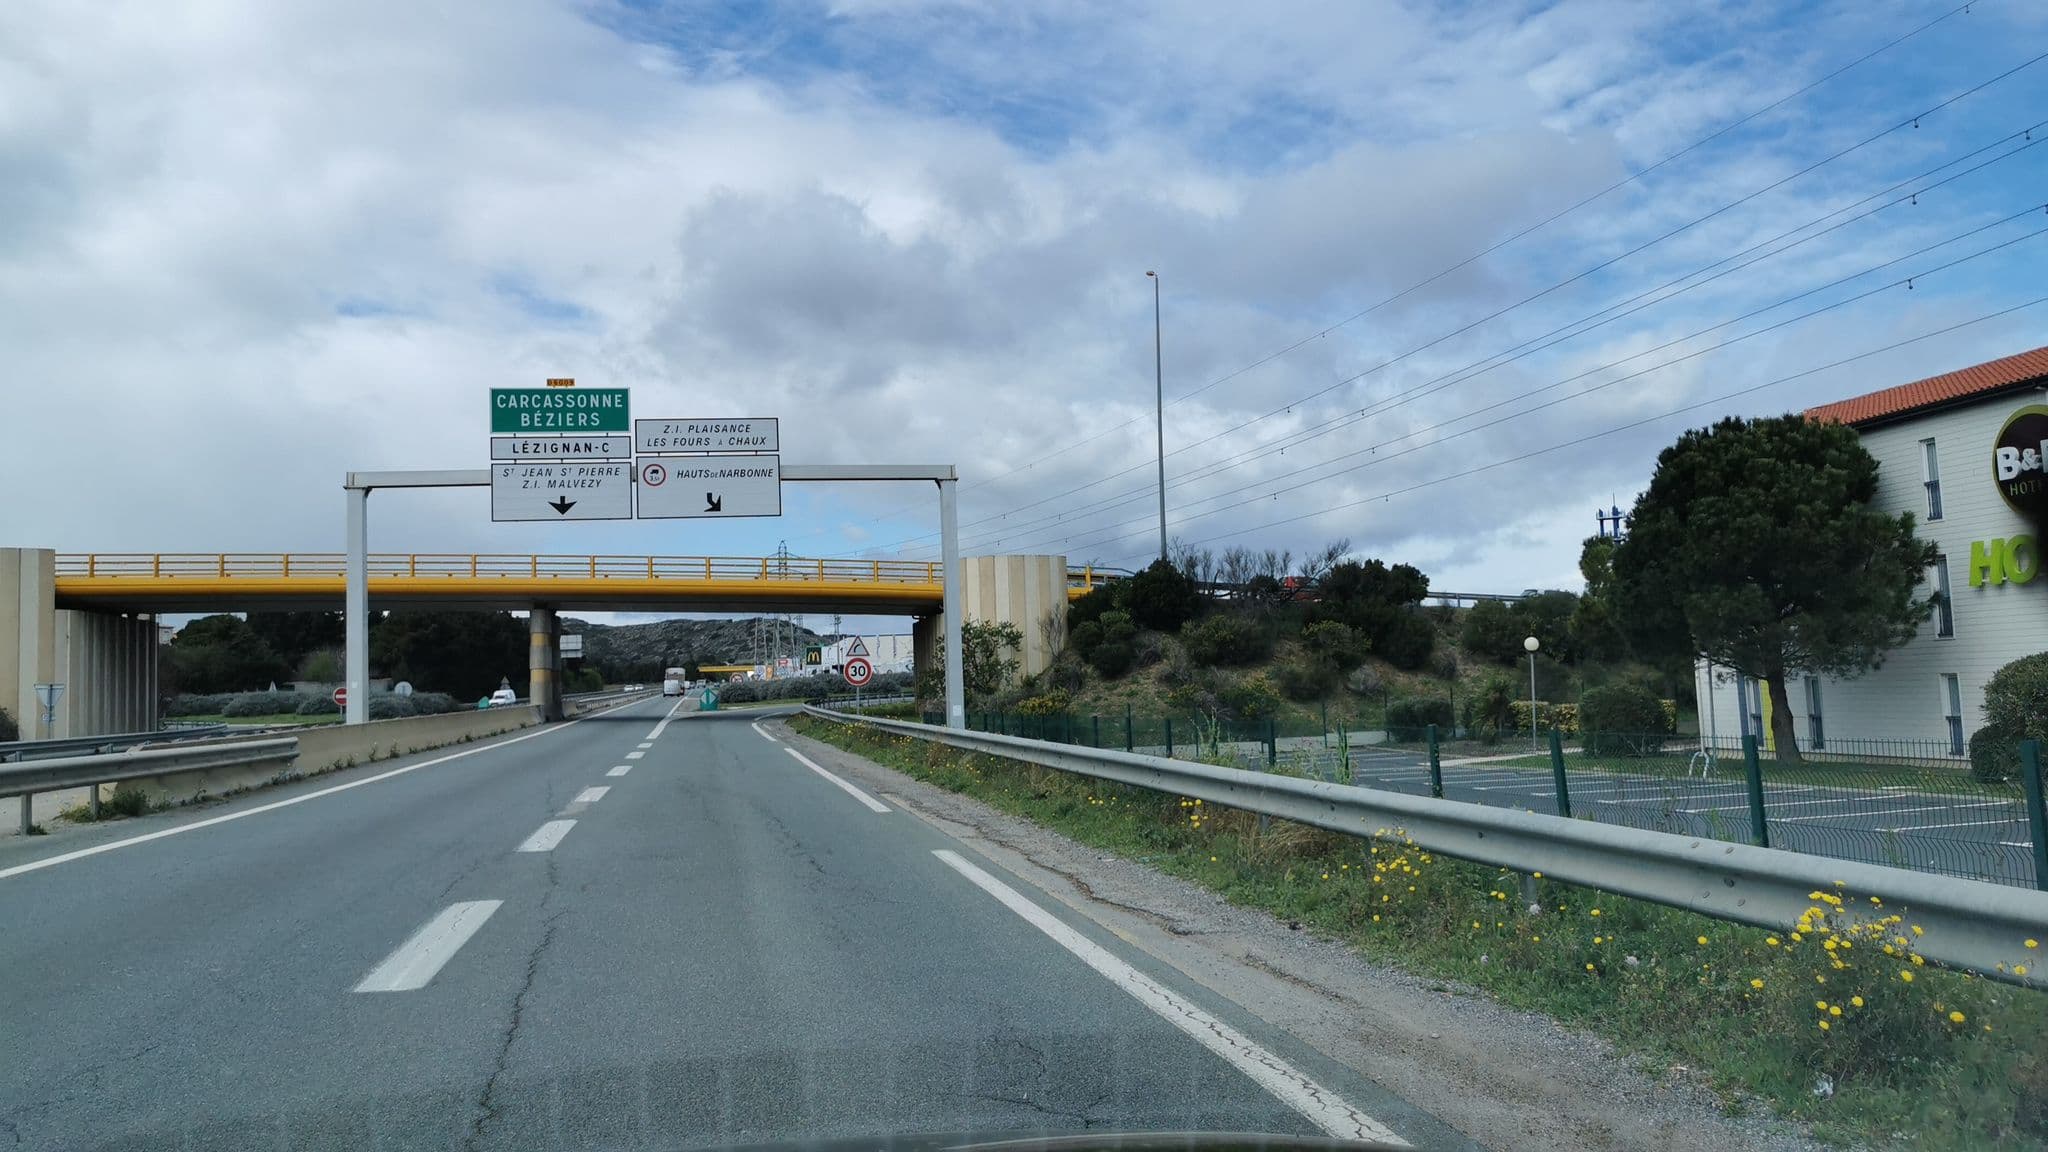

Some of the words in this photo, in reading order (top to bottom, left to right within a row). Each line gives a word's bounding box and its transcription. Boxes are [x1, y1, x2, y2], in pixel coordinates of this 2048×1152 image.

[496, 394, 624, 408] CARCASSONNE
[520, 410, 600, 427] BÉZIERS
[663, 424, 682, 434] Z.I.
[687, 423, 752, 433] PLAISANCE
[512, 440, 610, 454] LÉZIGNAN-C
[646, 437, 667, 447] LES
[672, 437, 711, 447] FOURS
[727, 436, 767, 446] CHAUX
[521, 468, 553, 477] JEAN
[578, 466, 621, 476] PIERRE
[676, 469, 710, 479] HAUTS
[719, 468, 774, 478] NARBONNE
[522, 479, 541, 489] Z.I.
[547, 478, 602, 489] MALVEZY
[850, 665, 866, 677] 30
